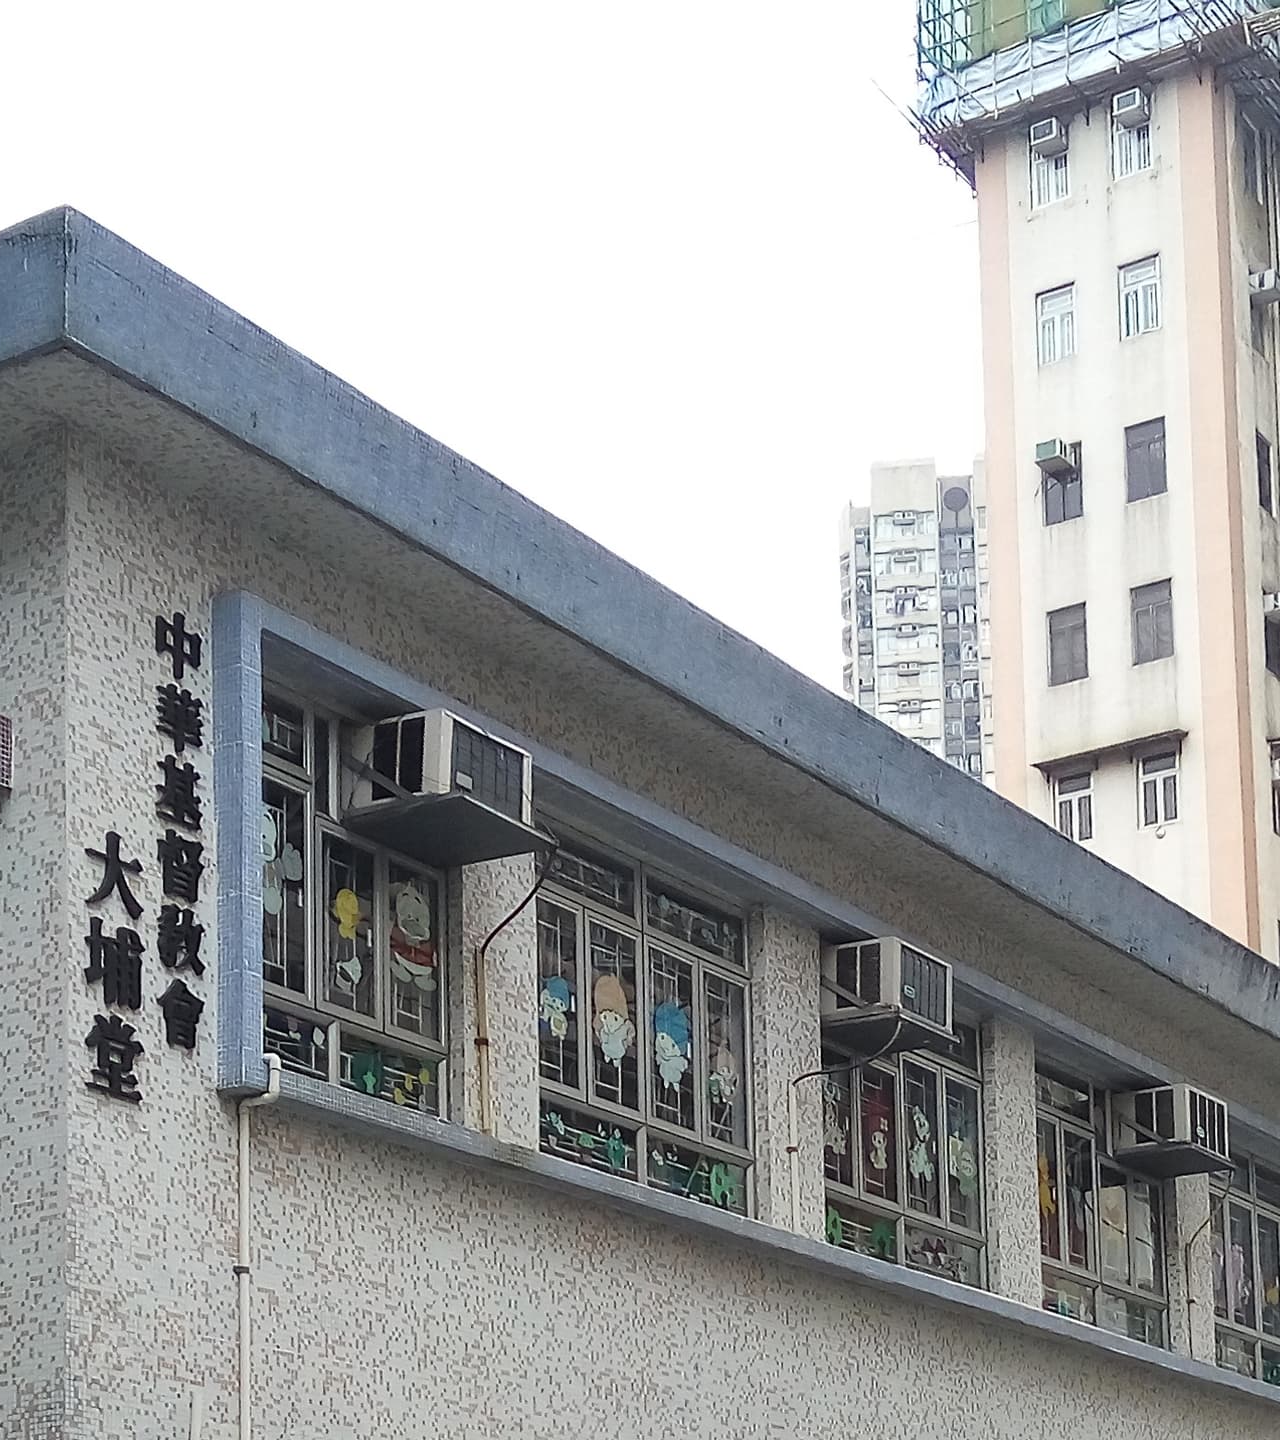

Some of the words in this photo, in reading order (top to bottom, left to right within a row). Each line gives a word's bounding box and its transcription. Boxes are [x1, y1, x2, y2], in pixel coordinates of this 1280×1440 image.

[84, 830, 145, 1102] 大埔堂
[154, 611, 205, 1051] 中華基督教會
